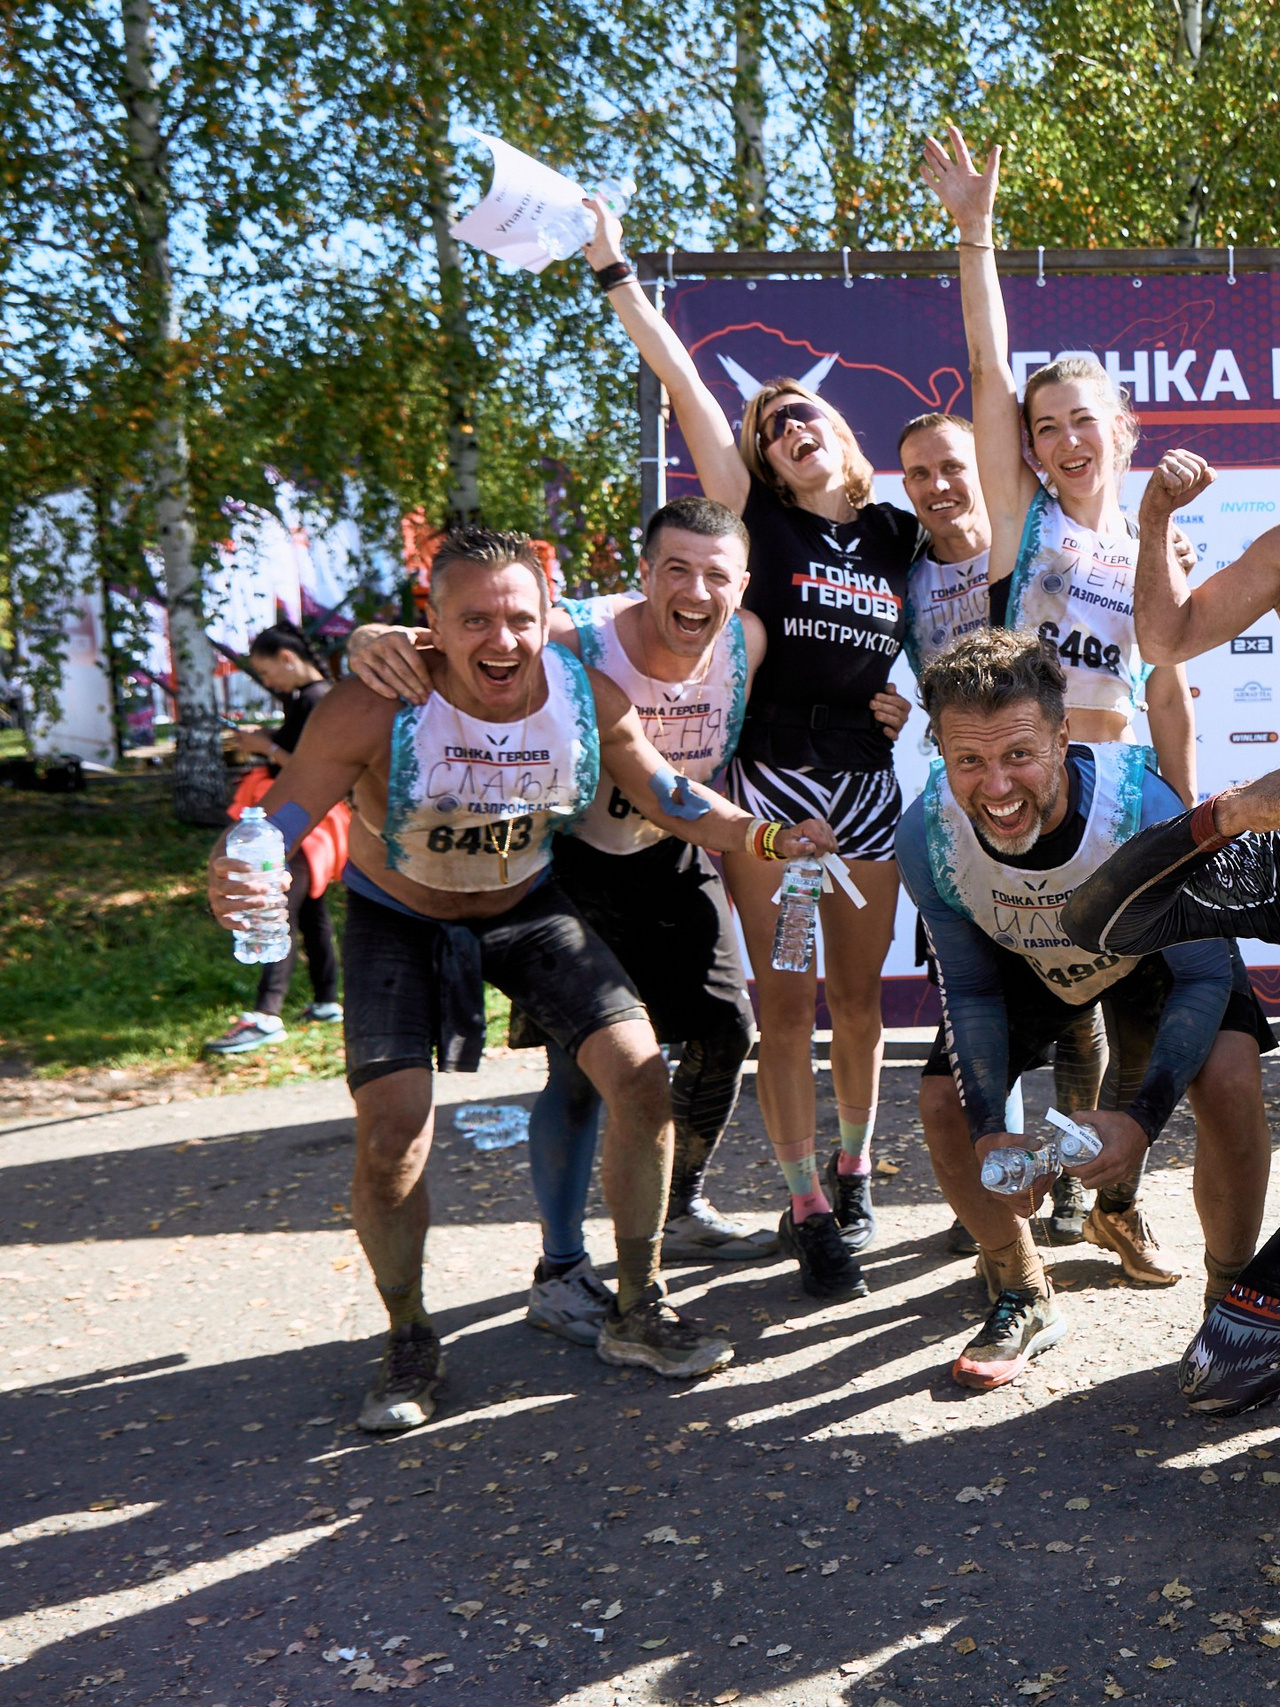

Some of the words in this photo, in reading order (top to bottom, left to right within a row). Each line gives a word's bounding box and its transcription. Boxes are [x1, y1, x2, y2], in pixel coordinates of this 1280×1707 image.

[1010, 349, 1250, 402] ГНКА
[1220, 501, 1276, 512] INVITRO
[809, 561, 893, 598] ГОНКА
[931, 583, 966, 599] ГОНКА
[801, 581, 899, 623] ГЕРОЕВ
[445, 746, 493, 761] ГОНКА
[498, 750, 550, 762] ГЕРОЕВ
[426, 762, 570, 800] СЛАВА
[992, 889, 1034, 906] ГОНКА
